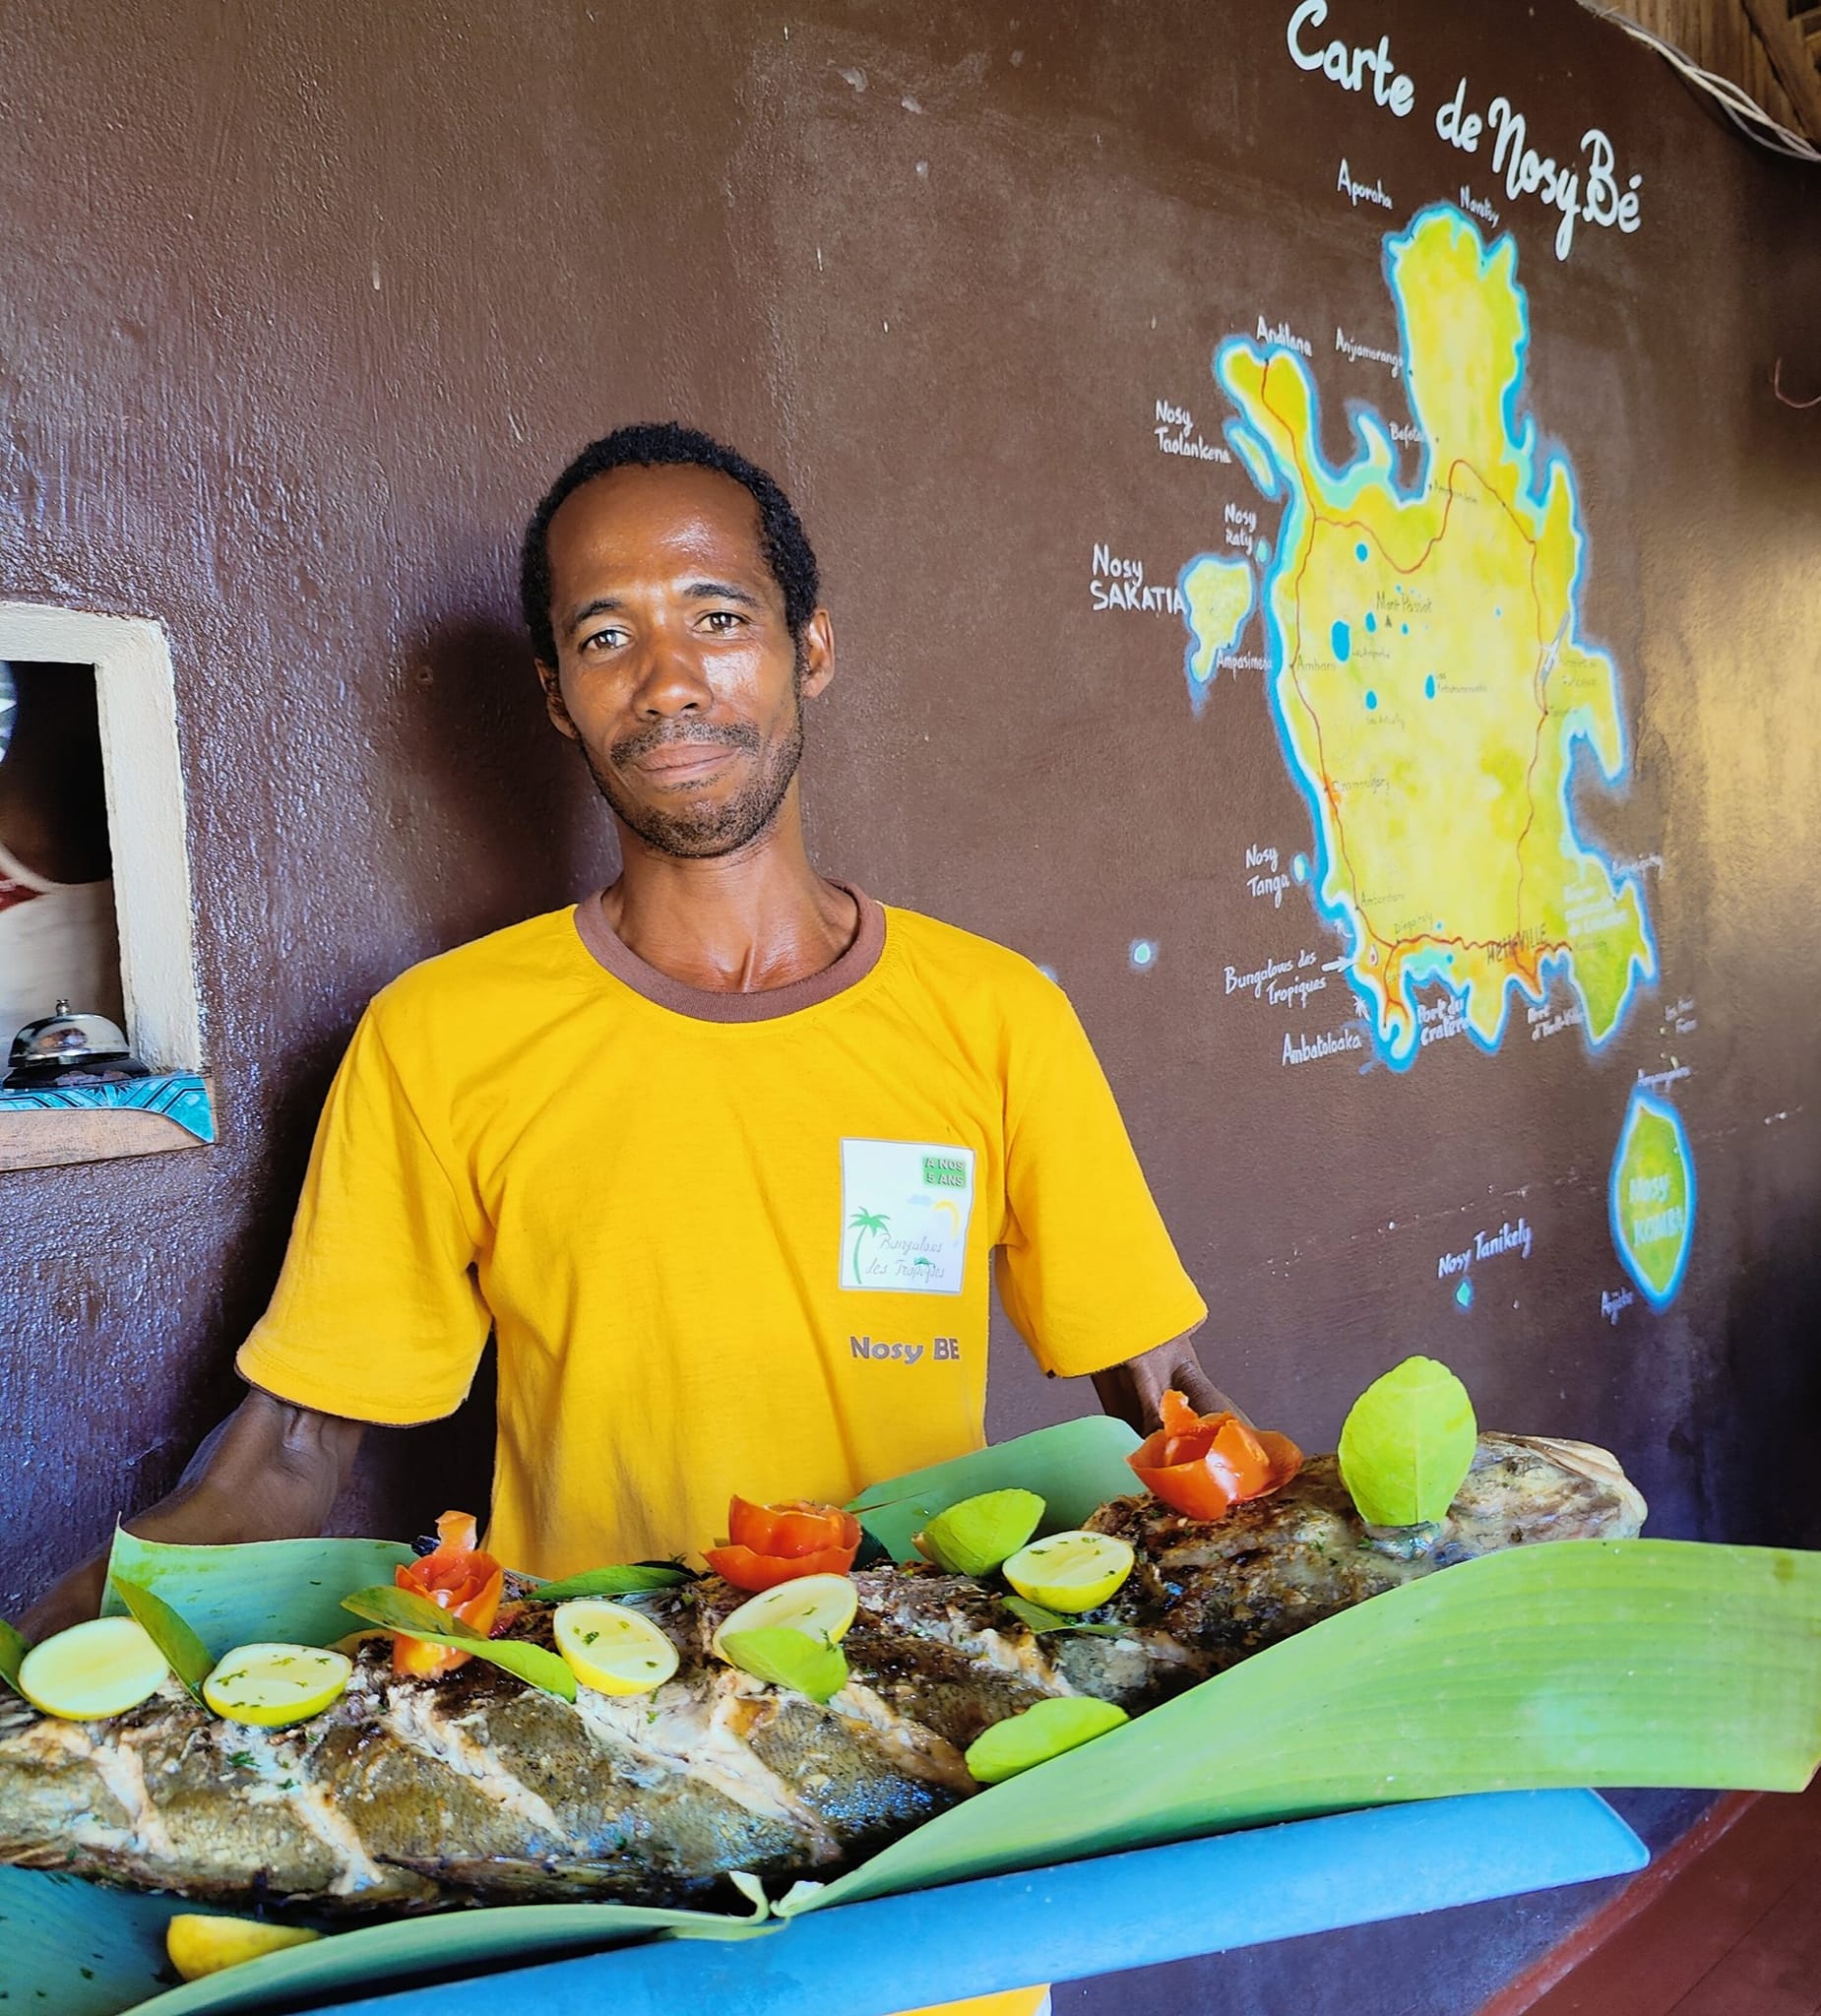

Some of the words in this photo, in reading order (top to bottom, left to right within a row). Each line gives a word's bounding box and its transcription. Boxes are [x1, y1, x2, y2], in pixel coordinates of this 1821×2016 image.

[1287, 0, 1414, 117] Carte
[1435, 78, 1483, 154] de
[1488, 96, 1580, 263] Nosy
[1581, 129, 1642, 234] Bé
[1156, 400, 1194, 437] Nosy
[1224, 503, 1257, 533] Nosy
[1092, 542, 1144, 588] Nosy
[1089, 579, 1187, 615] SAKATIA
[1245, 844, 1279, 873] Nosy
[1246, 873, 1290, 909] Tanga
[925, 1158, 935, 1168] A
[938, 1158, 965, 1171] NOS
[926, 1172, 936, 1183] 5
[940, 1174, 964, 1187] ANS
[1438, 1249, 1472, 1278] Nosy
[1474, 1218, 1533, 1259] Tanikely
[850, 1336, 923, 1364] Nosy
[933, 1338, 961, 1360] BE
